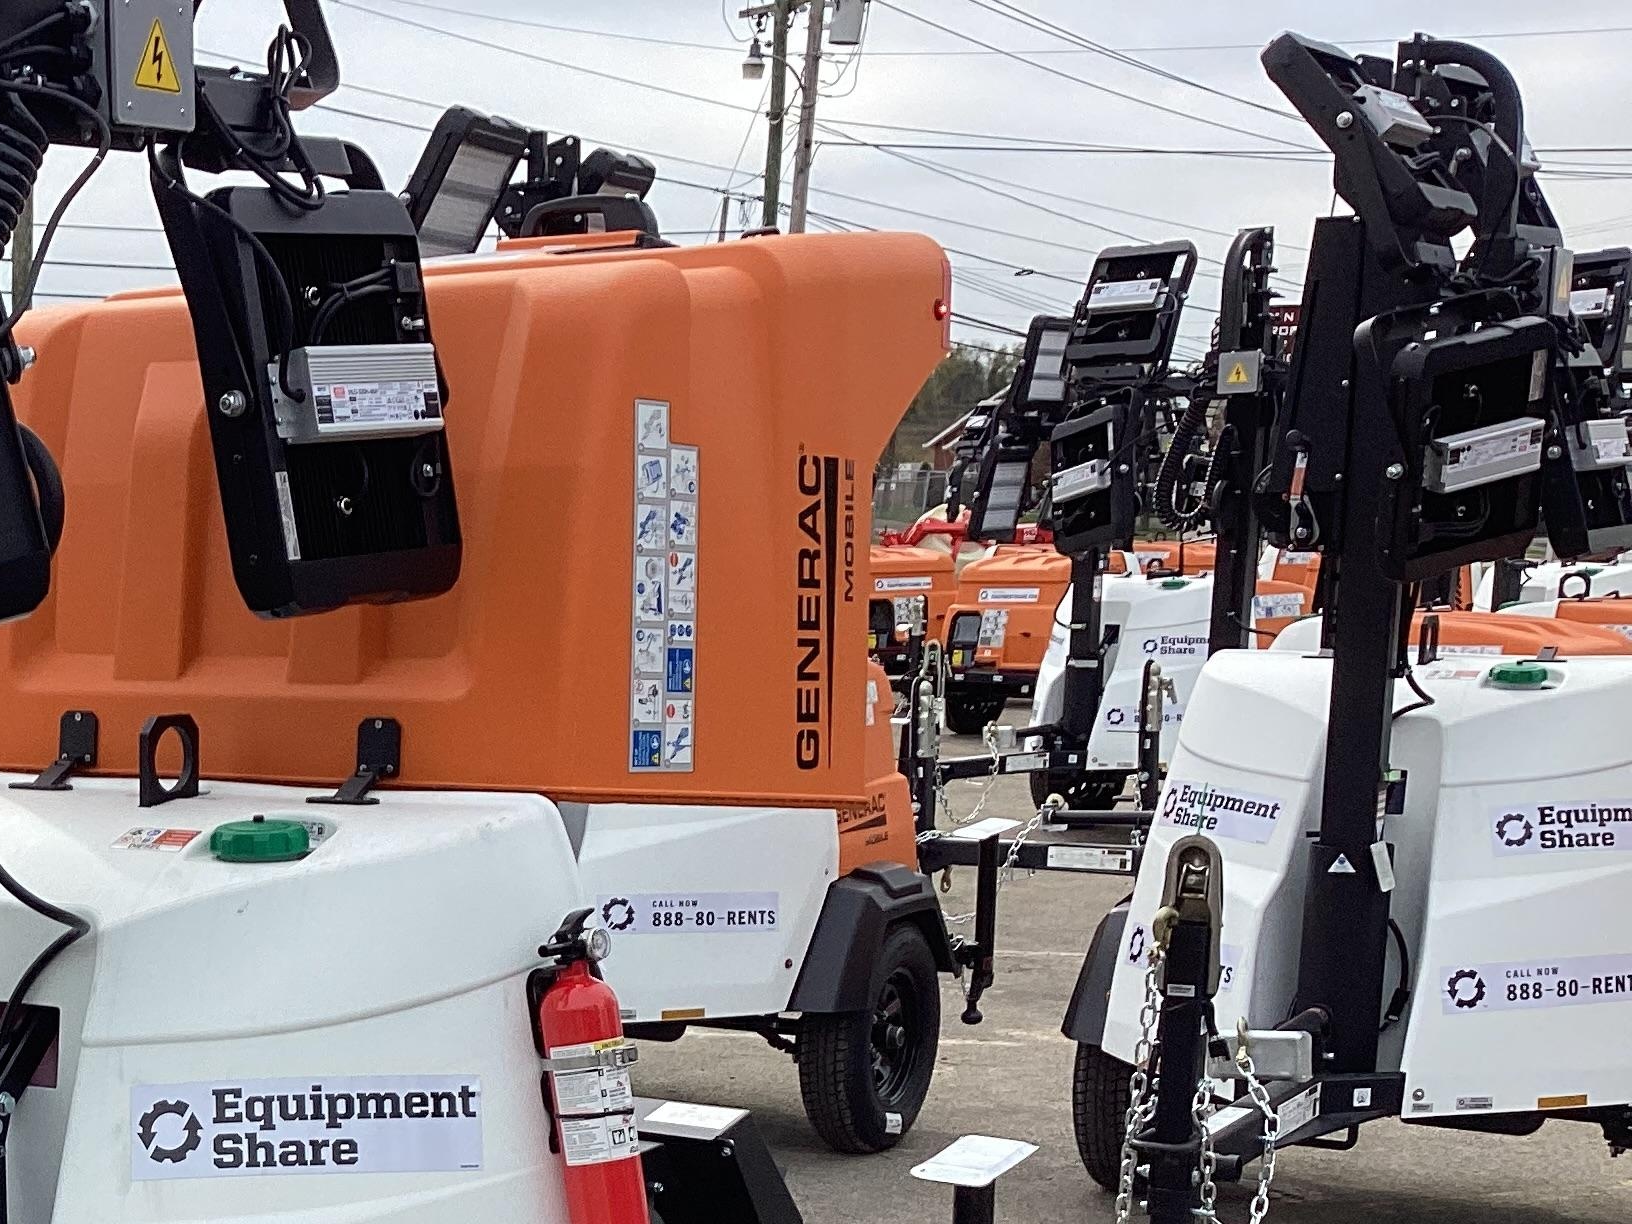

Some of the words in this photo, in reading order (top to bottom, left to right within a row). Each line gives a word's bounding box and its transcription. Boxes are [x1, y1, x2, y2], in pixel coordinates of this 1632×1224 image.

[844, 458, 856, 602] MOBILE
[796, 454, 821, 770] GENERAC
[1159, 645, 1196, 655] Share
[1160, 635, 1210, 646] Equipm
[1178, 784, 1281, 820] Equipment
[1173, 806, 1218, 831] Share
[1537, 804, 1632, 829] Equipm
[1539, 829, 1615, 849] Share
[652, 900, 675, 908] CALL
[678, 899, 699, 907] NOW
[652, 910, 776, 927] 888-80-RENTS
[1505, 968, 1532, 979] CALL
[1536, 966, 1560, 977] NOW
[1506, 974, 1632, 1002] 888-80-RENT
[211, 1084, 477, 1131] Equipment
[212, 1131, 359, 1169] Share
